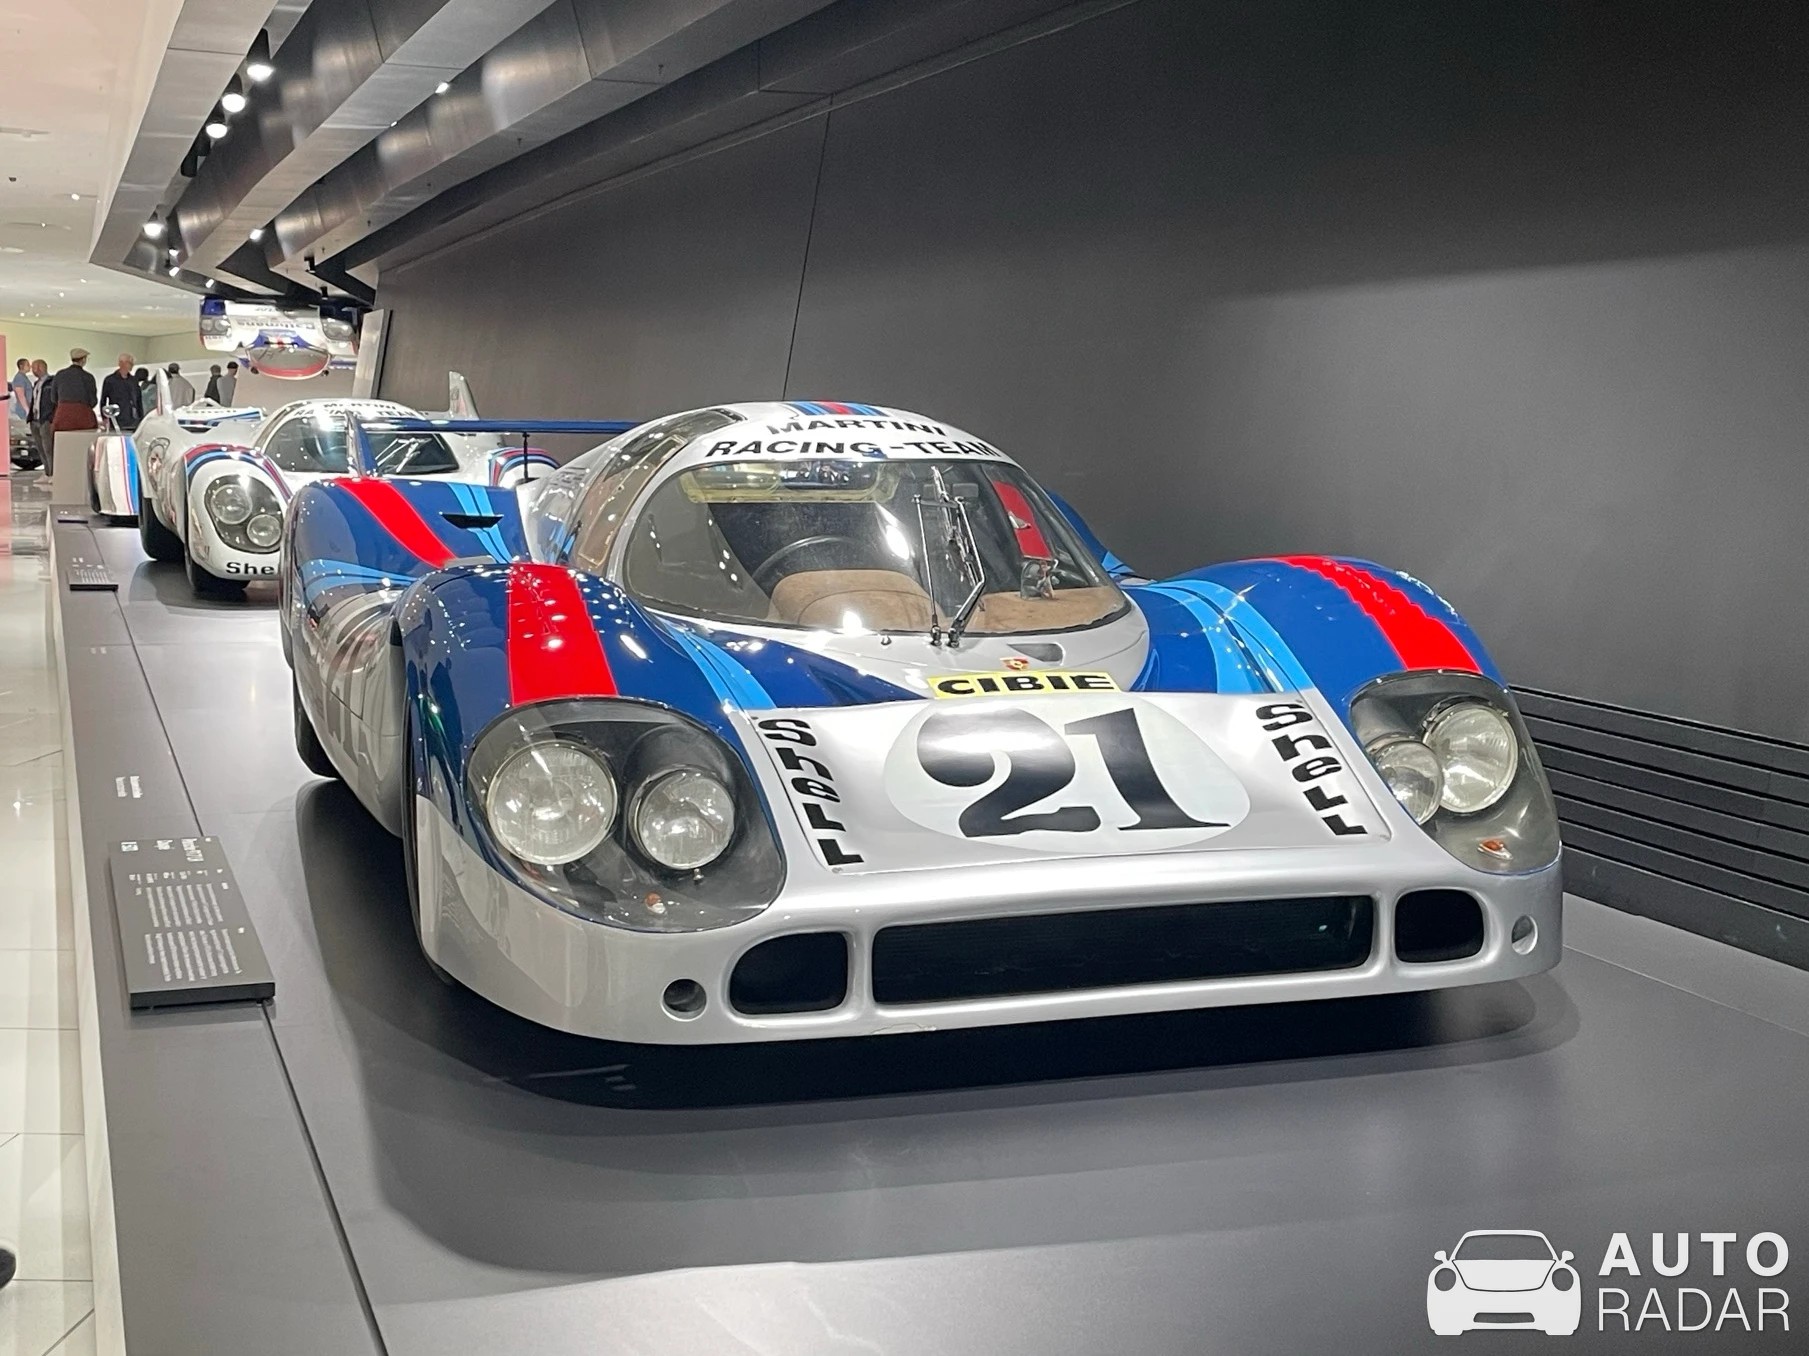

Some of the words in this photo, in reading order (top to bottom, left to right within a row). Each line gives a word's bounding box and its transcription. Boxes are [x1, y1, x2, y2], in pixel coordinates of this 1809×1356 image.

[766, 420, 946, 436] MARTINI
[226, 561, 275, 575] She
[937, 674, 1115, 695] CIBIE
[917, 707, 1231, 838] 21
